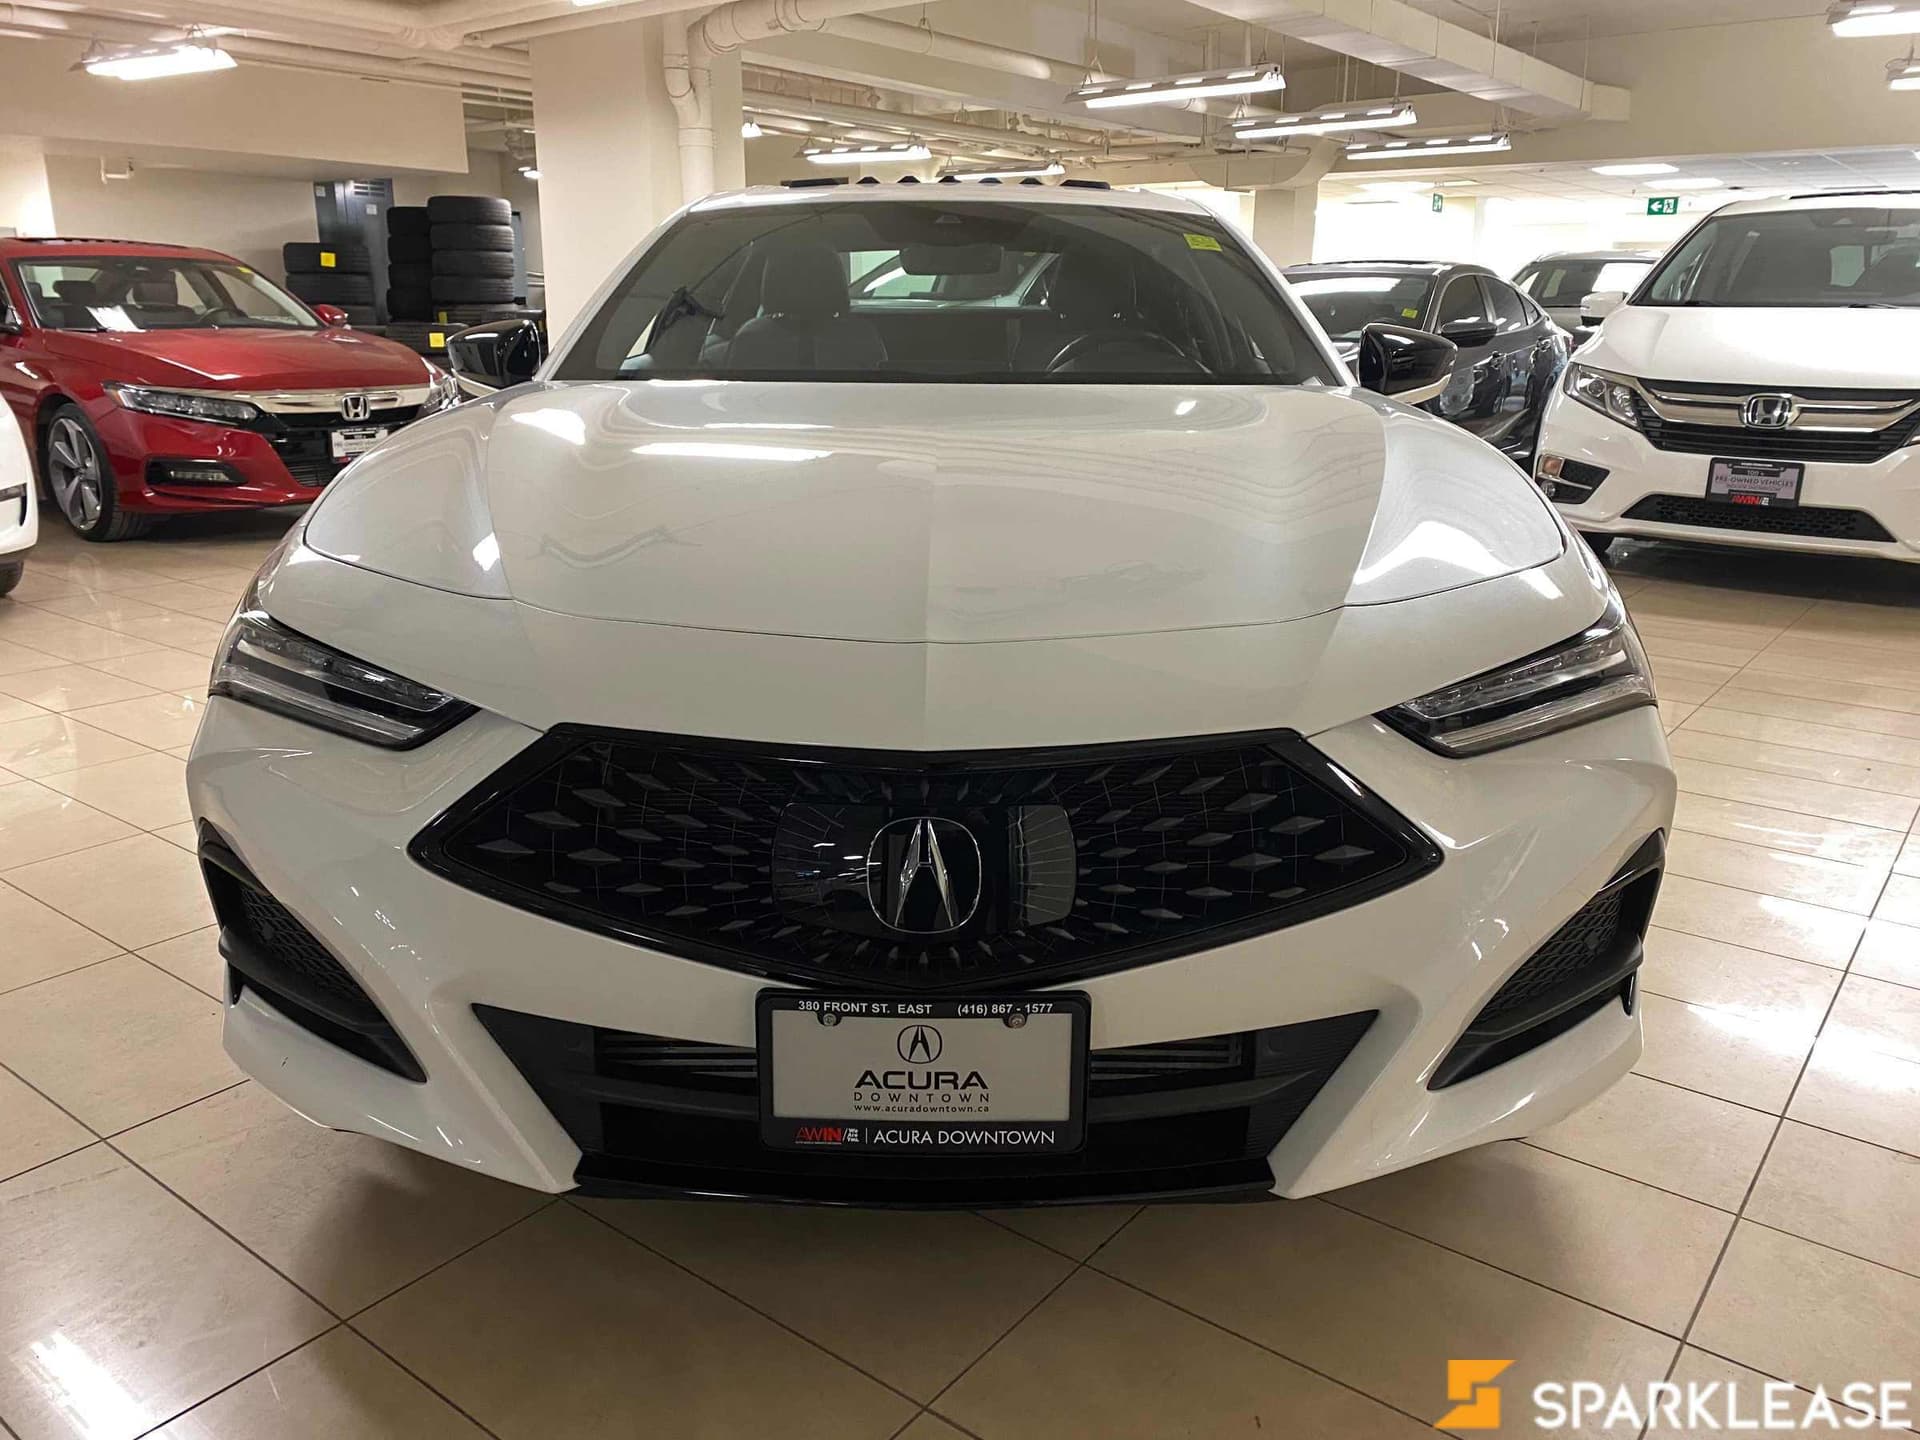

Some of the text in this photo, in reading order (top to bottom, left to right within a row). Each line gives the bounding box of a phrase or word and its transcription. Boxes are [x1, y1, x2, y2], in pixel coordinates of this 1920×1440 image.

[1760, 478, 1794, 488] VEHICLES
[798, 1001, 820, 1011] 380
[823, 1001, 868, 1013] FRONT
[871, 1003, 891, 1014] ST.
[897, 1003, 933, 1015] EAST
[957, 1003, 988, 1017] (416)
[991, 1003, 1013, 1014] 867
[1024, 1003, 1054, 1013] 1577
[854, 1070, 989, 1090] ACURA
[853, 1092, 990, 1103] DOWNTOWN
[854, 1104, 990, 1113] www.acuradowntown.ca
[873, 1130, 1055, 1145] ACURA DOWNTOWN
